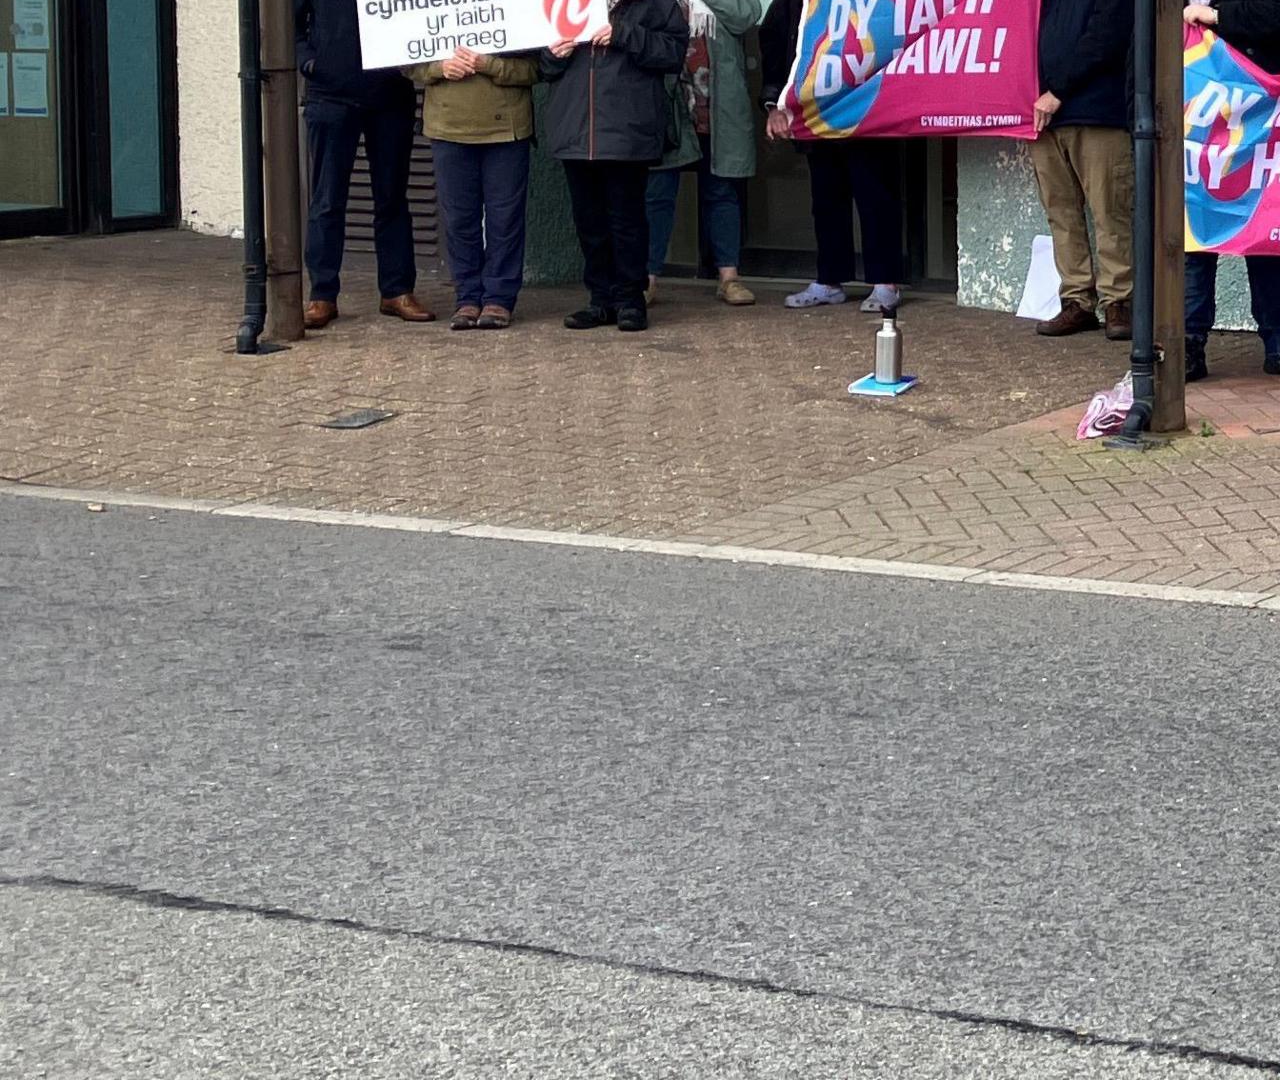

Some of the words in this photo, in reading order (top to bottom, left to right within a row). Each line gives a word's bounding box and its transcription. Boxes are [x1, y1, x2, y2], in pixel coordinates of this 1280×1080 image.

[407, 28, 507, 60] gymraeg
[426, 13, 448, 36] yr
[456, 3, 505, 26] iaith
[813, 52, 876, 97] DY
[885, 27, 1007, 75] AWL!
[1187, 80, 1263, 130] DY
[1184, 139, 1239, 190] DY
